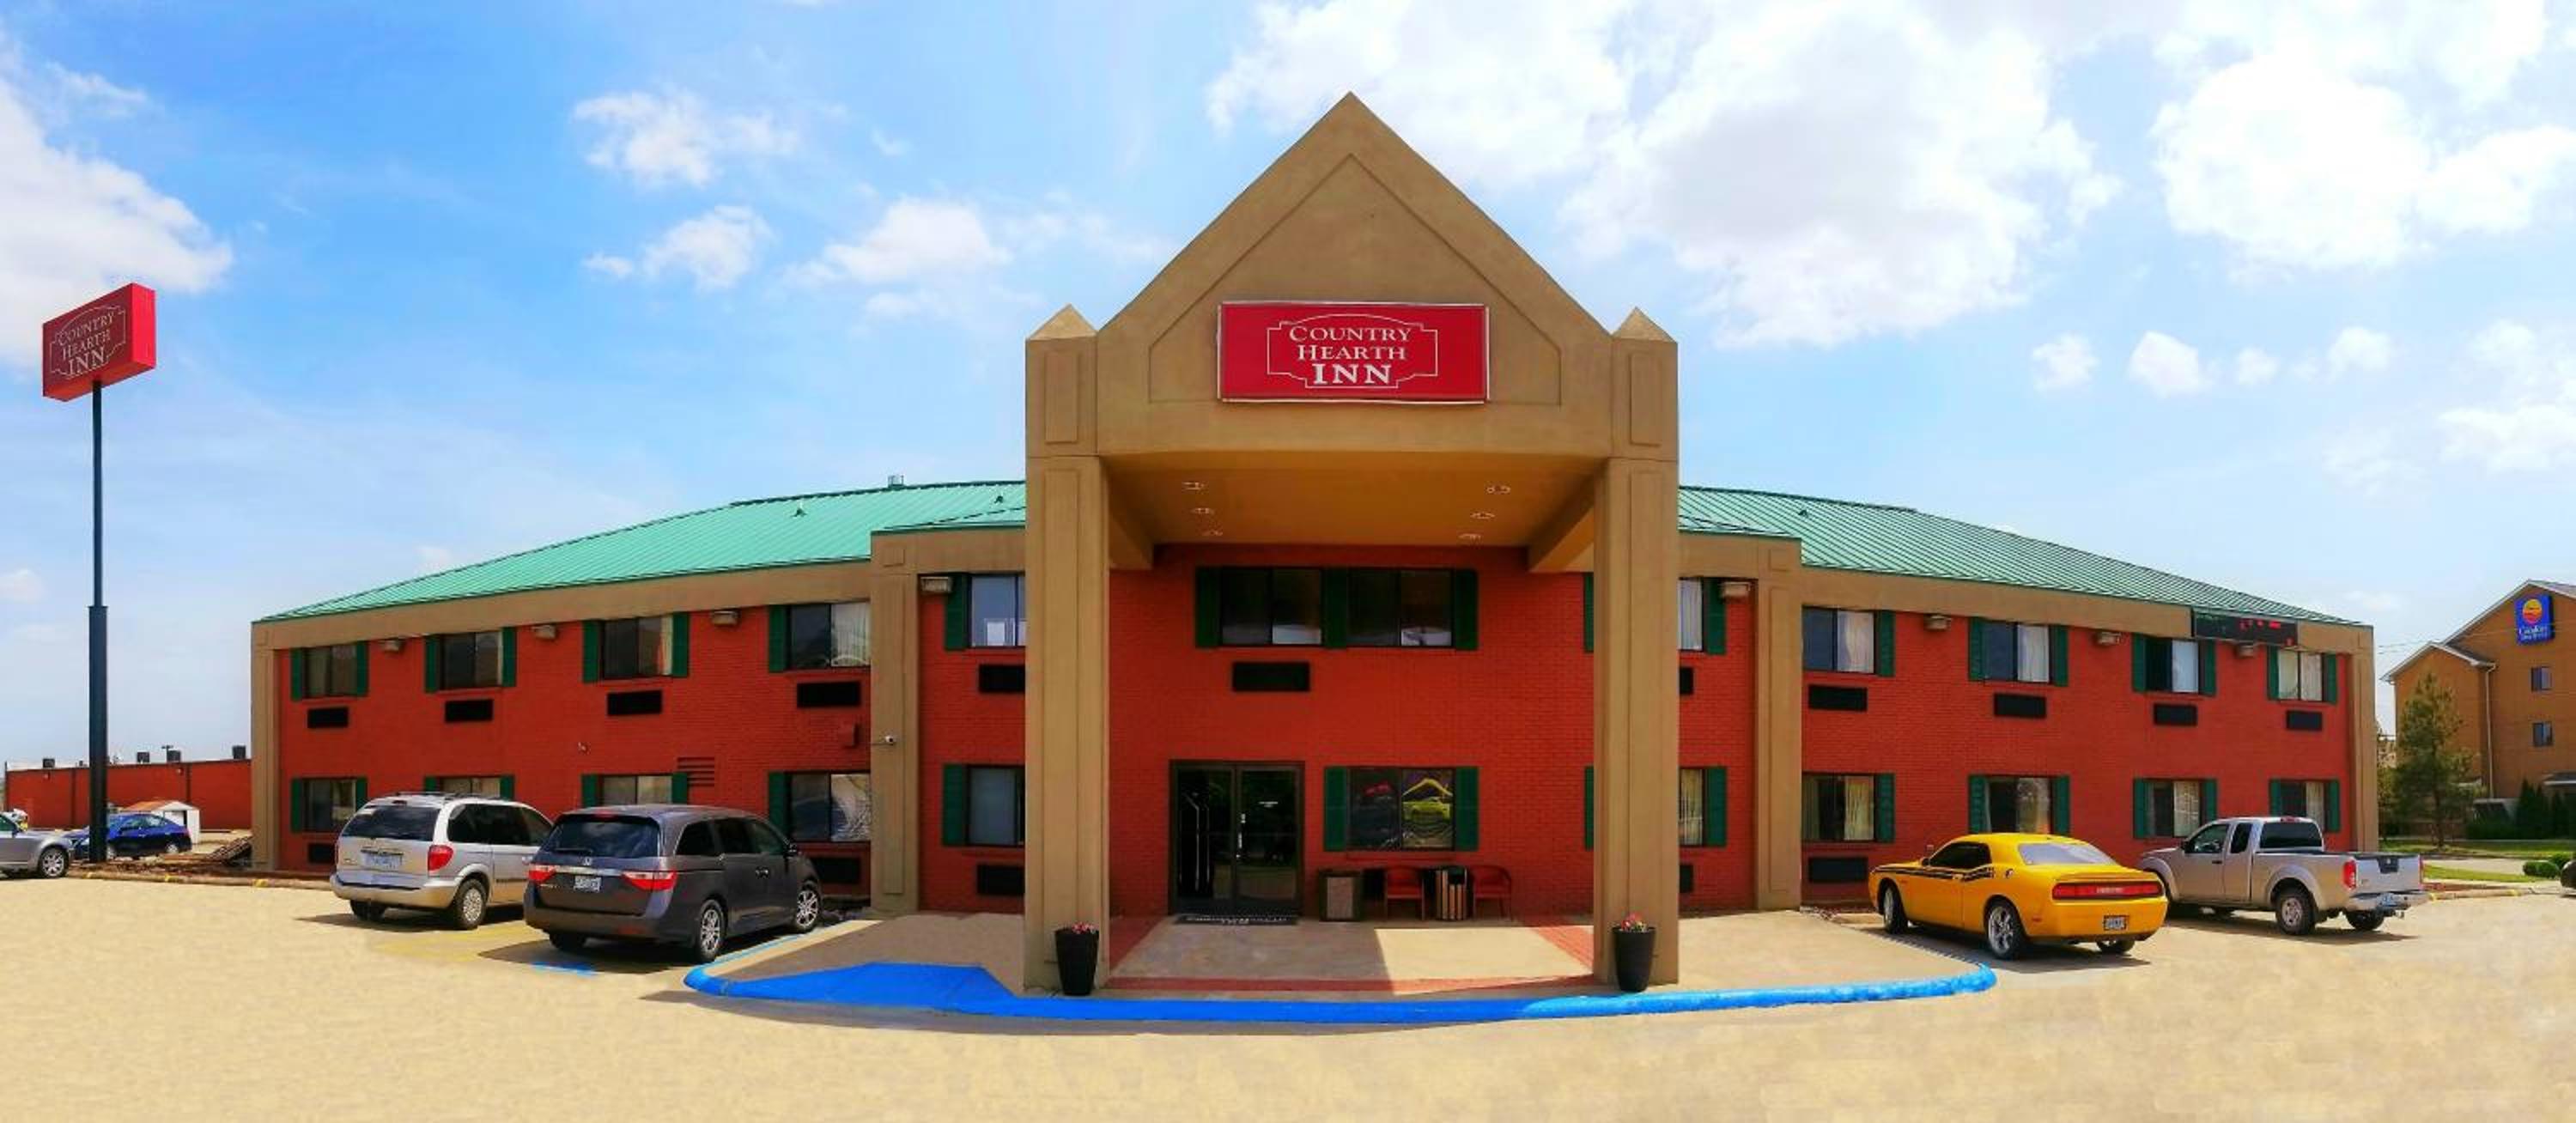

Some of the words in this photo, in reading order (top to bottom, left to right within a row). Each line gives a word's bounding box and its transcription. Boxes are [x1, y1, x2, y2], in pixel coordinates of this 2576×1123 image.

[58, 312, 114, 346] COUNTRY
[1289, 326, 1411, 342] COUNTRY
[62, 330, 111, 361] HEARTH
[1297, 344, 1406, 361] HEARTH
[68, 345, 105, 375] INN
[1312, 363, 1392, 384] INN
